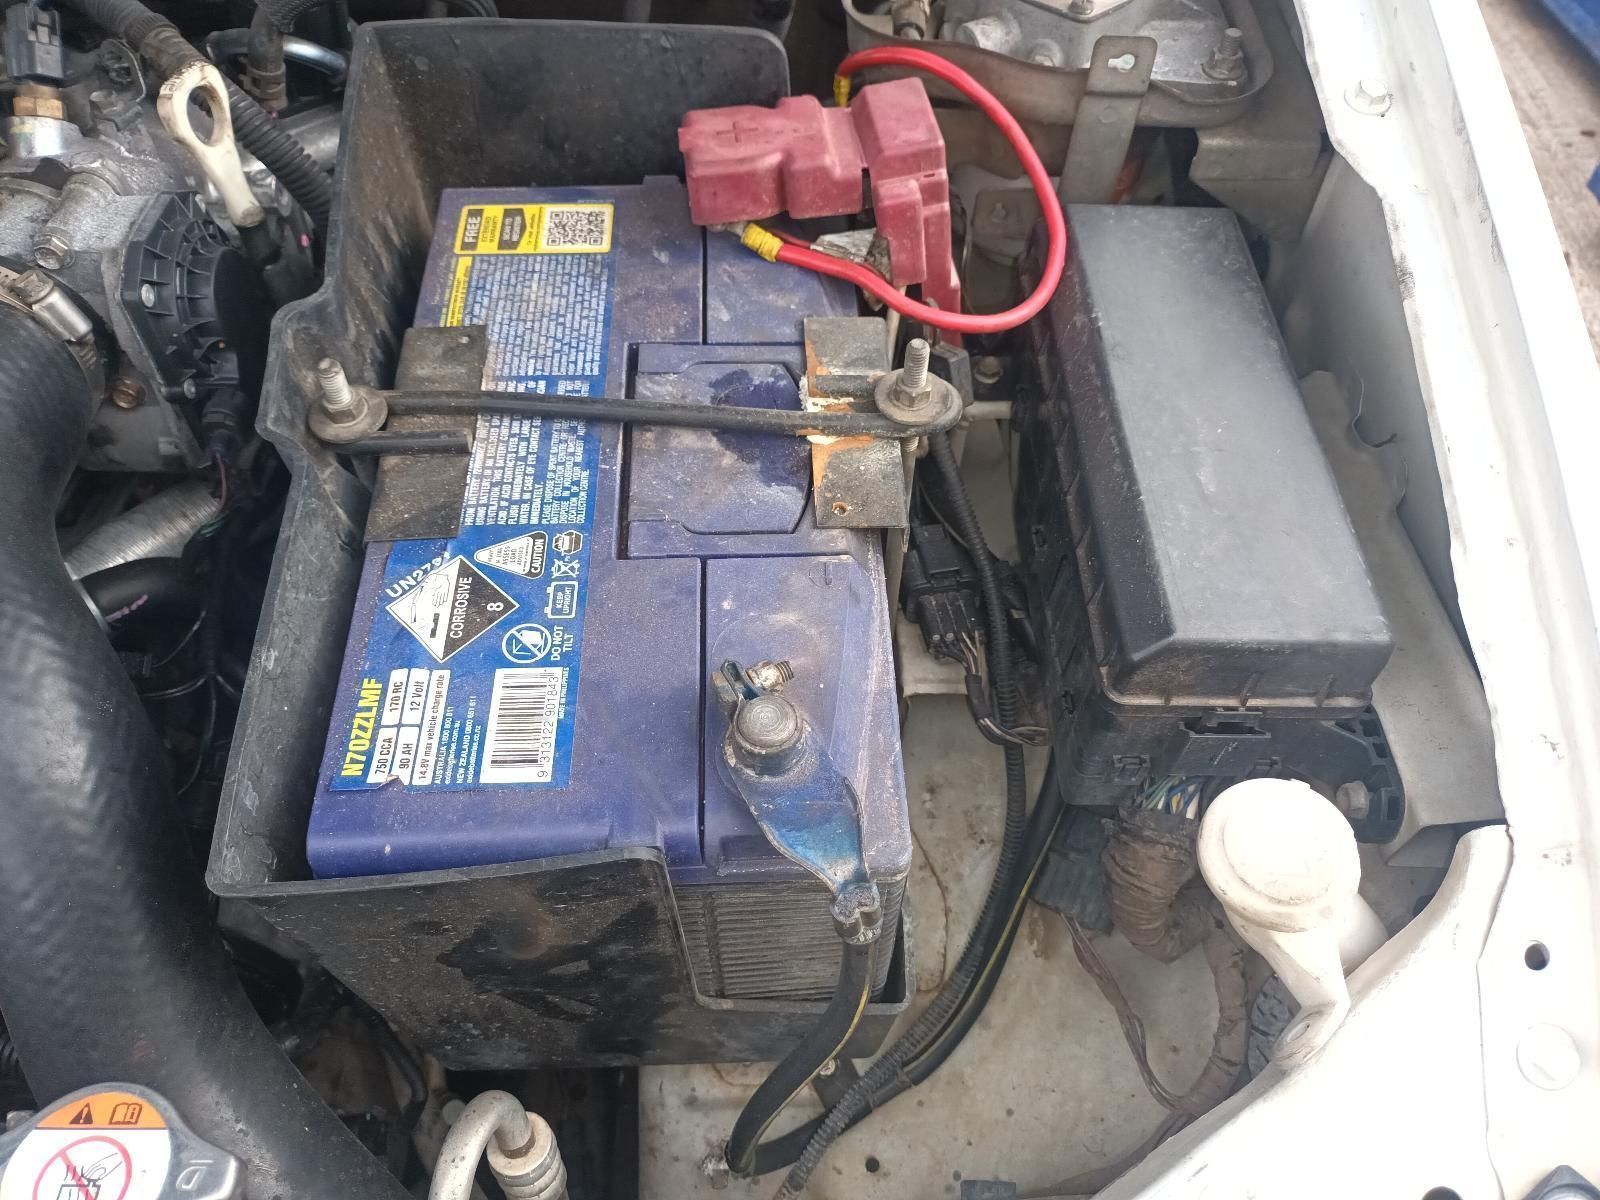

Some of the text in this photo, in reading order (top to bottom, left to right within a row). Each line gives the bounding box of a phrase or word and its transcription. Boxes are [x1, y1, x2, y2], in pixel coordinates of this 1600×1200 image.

[464, 216, 481, 243] FREE
[511, 421, 521, 433] SKIN
[521, 420, 531, 437] LARGE
[487, 428, 499, 456] ENCLOSED
[518, 442, 528, 456] WITH
[529, 428, 541, 452] CONTACT
[550, 431, 561, 453] BATTERY
[575, 440, 584, 462] NEAREST
[496, 443, 507, 466] BATTERY
[527, 454, 537, 464] EYE
[549, 456, 557, 470] SPENT
[493, 470, 503, 482] THIS
[504, 454, 516, 482] CONTACTS
[564, 457, 574, 487] HOUSEHOLD
[573, 467, 582, 481] YOUR
[468, 478, 481, 505] BATTERY
[479, 479, 491, 503] BATTERY
[501, 485, 512, 498] ACID
[512, 461, 525, 500] IMMEDIATELY
[524, 476, 534, 490] CASE
[545, 480, 555, 502] DISPOSE
[554, 466, 565, 496] COLLECTION
[487, 486, 501, 525] VENTILATION.
[509, 505, 520, 524] FLUSH
[519, 502, 531, 524] WATER.
[531, 482, 543, 524] IMMEDIATELY.
[542, 504, 552, 524] PLEASE
[551, 501, 560, 524] BATTERY
[560, 501, 570, 524] DISPOSE
[569, 498, 578, 523] LOCATION
[577, 492, 587, 523] COLLECTION
[465, 508, 475, 526] FROM
[476, 507, 487, 525] USING
[498, 509, 508, 525] ACID.
[510, 549, 518, 563] LOAD
[531, 539, 545, 573] CAUTION
[450, 577, 472, 638] CORROSIVE
[487, 602, 505, 612] 8
[564, 587, 572, 613] UPRIGHT
[552, 625, 564, 661] DO NOT
[564, 634, 574, 652] TILT
[561, 667, 570, 698] PHILIPPINES
[390, 681, 404, 712] 170 RC
[410, 681, 425, 711] 12 Volt
[545, 677, 559, 716] 901843
[342, 679, 384, 776] N70ZZLMF
[419, 675, 445, 780] 14.8V max vehicle charge rate
[465, 720, 473, 733] 0800
[460, 735, 471, 767] ZEALAND
[539, 722, 554, 763] 313122
[375, 738, 393, 774] 750 CCA
[399, 743, 414, 769] 90 AH
[435, 746, 448, 784] AUSTRALIA
[442, 730, 451, 744] 1800
[457, 768, 466, 783] NEW
